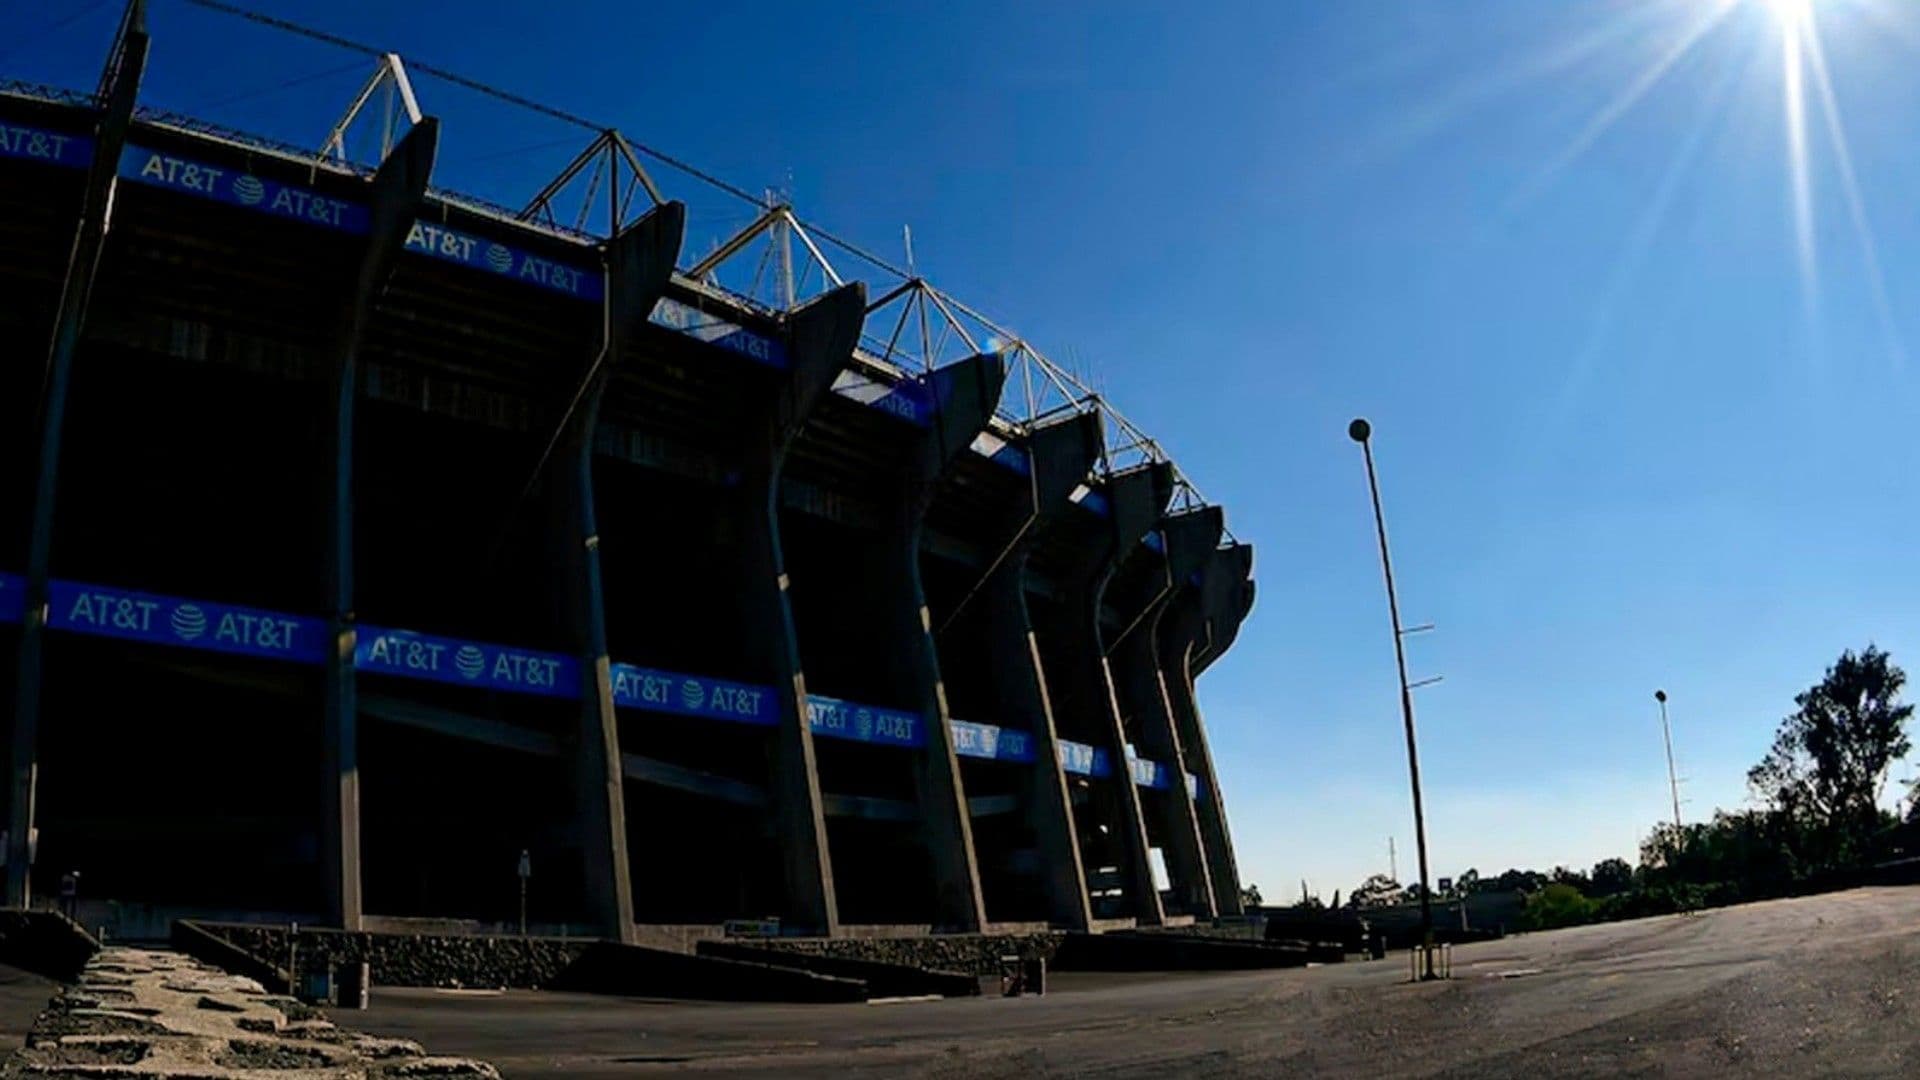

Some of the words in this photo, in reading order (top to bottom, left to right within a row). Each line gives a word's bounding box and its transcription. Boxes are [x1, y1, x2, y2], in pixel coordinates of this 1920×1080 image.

[141, 154, 224, 193] AT&T
[271, 188, 348, 225] AT&T
[405, 223, 477, 261] AT&T
[520, 260, 582, 293] AT&T
[69, 593, 158, 631] AT&T
[216, 613, 300, 649] AT&T
[370, 637, 444, 671] AT&T
[493, 652, 560, 687] AT&T
[613, 671, 672, 704] AT&T
[711, 686, 762, 716] AT&T
[806, 703, 848, 729] AT&T
[877, 715, 915, 740] AT&T
